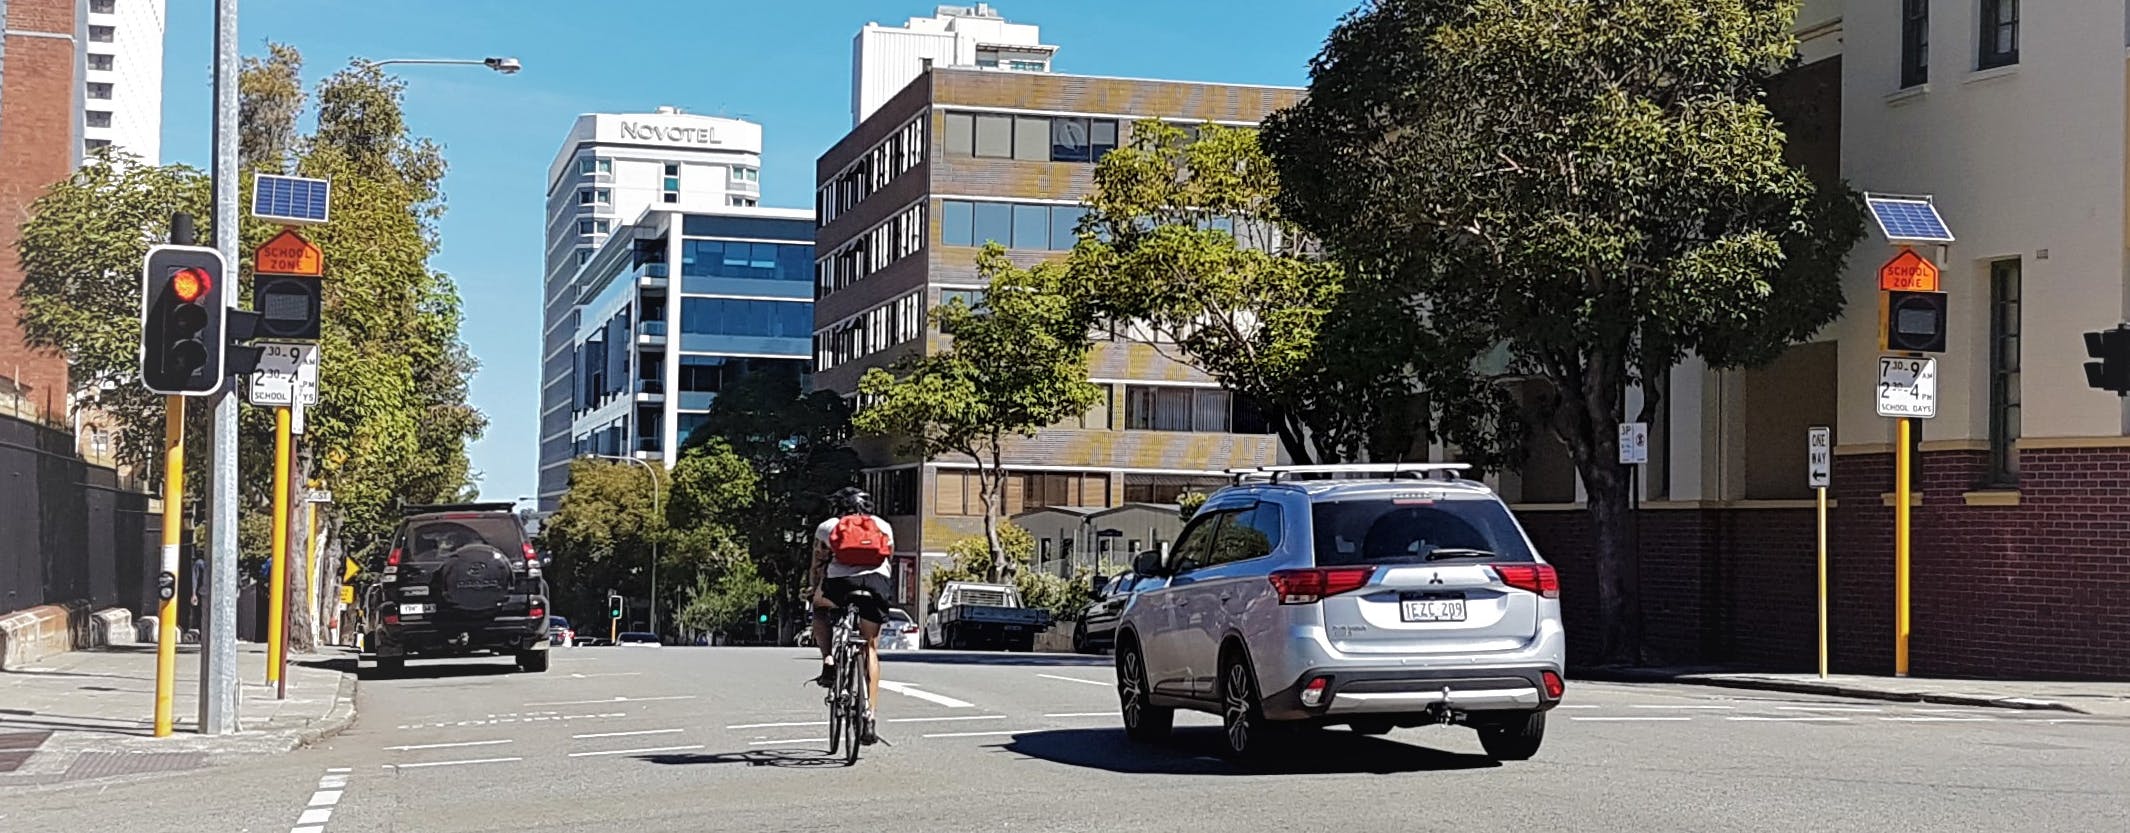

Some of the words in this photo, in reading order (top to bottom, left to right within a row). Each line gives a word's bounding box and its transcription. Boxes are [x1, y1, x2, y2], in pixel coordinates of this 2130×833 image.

[621, 121, 722, 144] NOVOTEL
[264, 247, 312, 259] SCHOOL
[271, 260, 304, 271] ZONE
[1887, 266, 1929, 277] SCHOOL
[1894, 278, 1923, 288] ZONE
[254, 392, 288, 401] SCHOOL
[1881, 403, 1908, 412] SCHOOL
[1812, 434, 1826, 447] ONE
[1812, 452, 1826, 465] WAY
